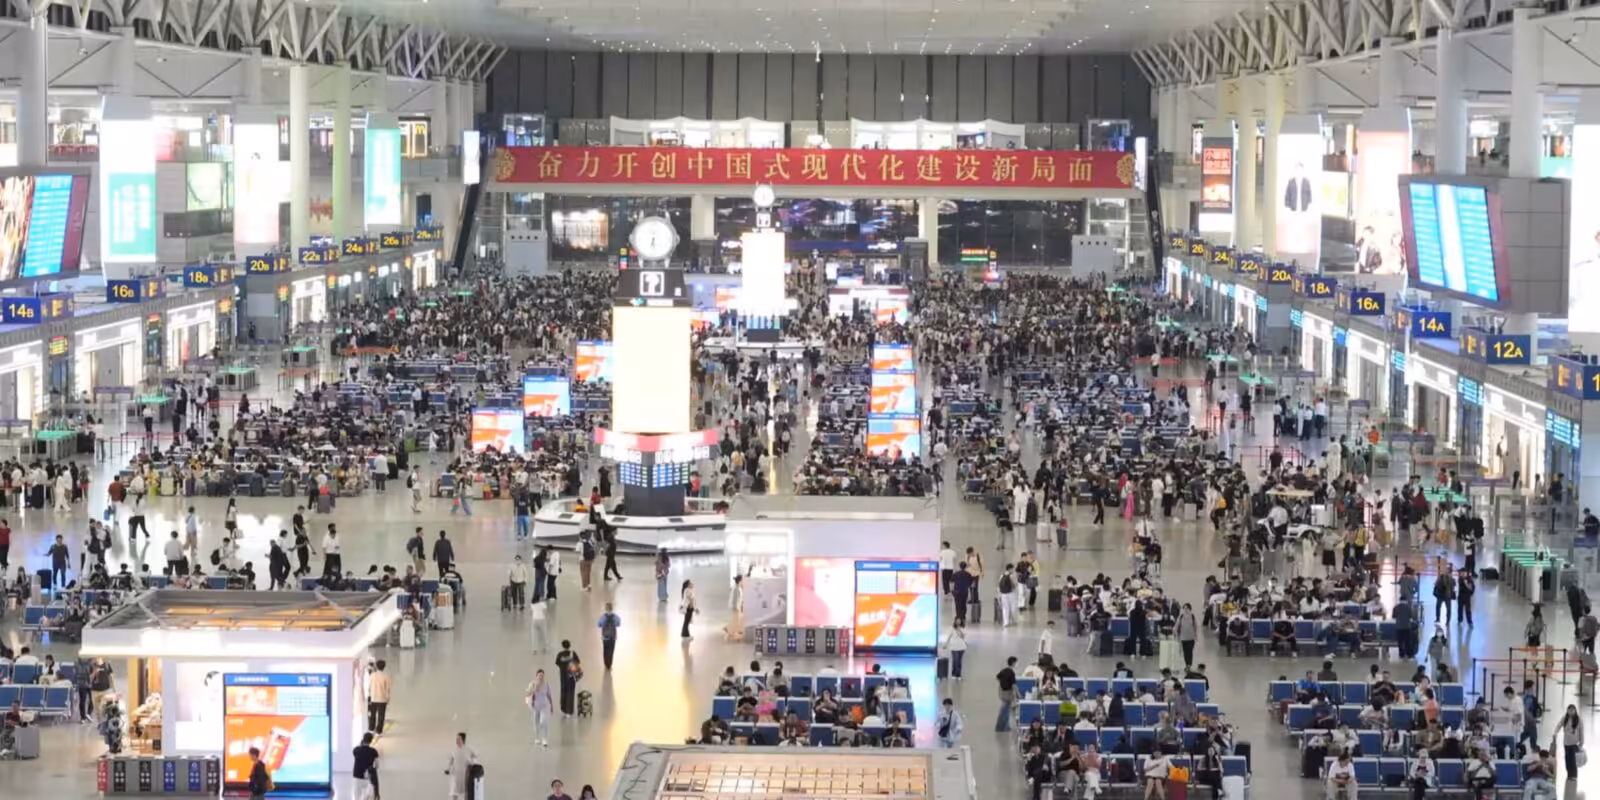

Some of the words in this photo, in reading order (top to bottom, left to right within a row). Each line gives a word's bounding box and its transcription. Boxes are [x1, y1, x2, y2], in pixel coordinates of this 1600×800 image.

[538, 150, 1093, 183] 奋力开创中国式现代化建设新局面
[384, 236, 399, 246] 26B
[346, 243, 363, 254] 24B
[1192, 244, 1205, 254] 26
[302, 251, 321, 262] 22B
[250, 260, 270, 272] 20B
[188, 271, 209, 284] 18B
[1272, 270, 1292, 281] 20A
[112, 284, 134, 298] 16B
[1310, 283, 1330, 293] 18A
[1356, 297, 1380, 310] 16A
[9, 303, 34, 318] 14B
[1419, 318, 1445, 332] 14A
[1493, 342, 1524, 359] 12A
